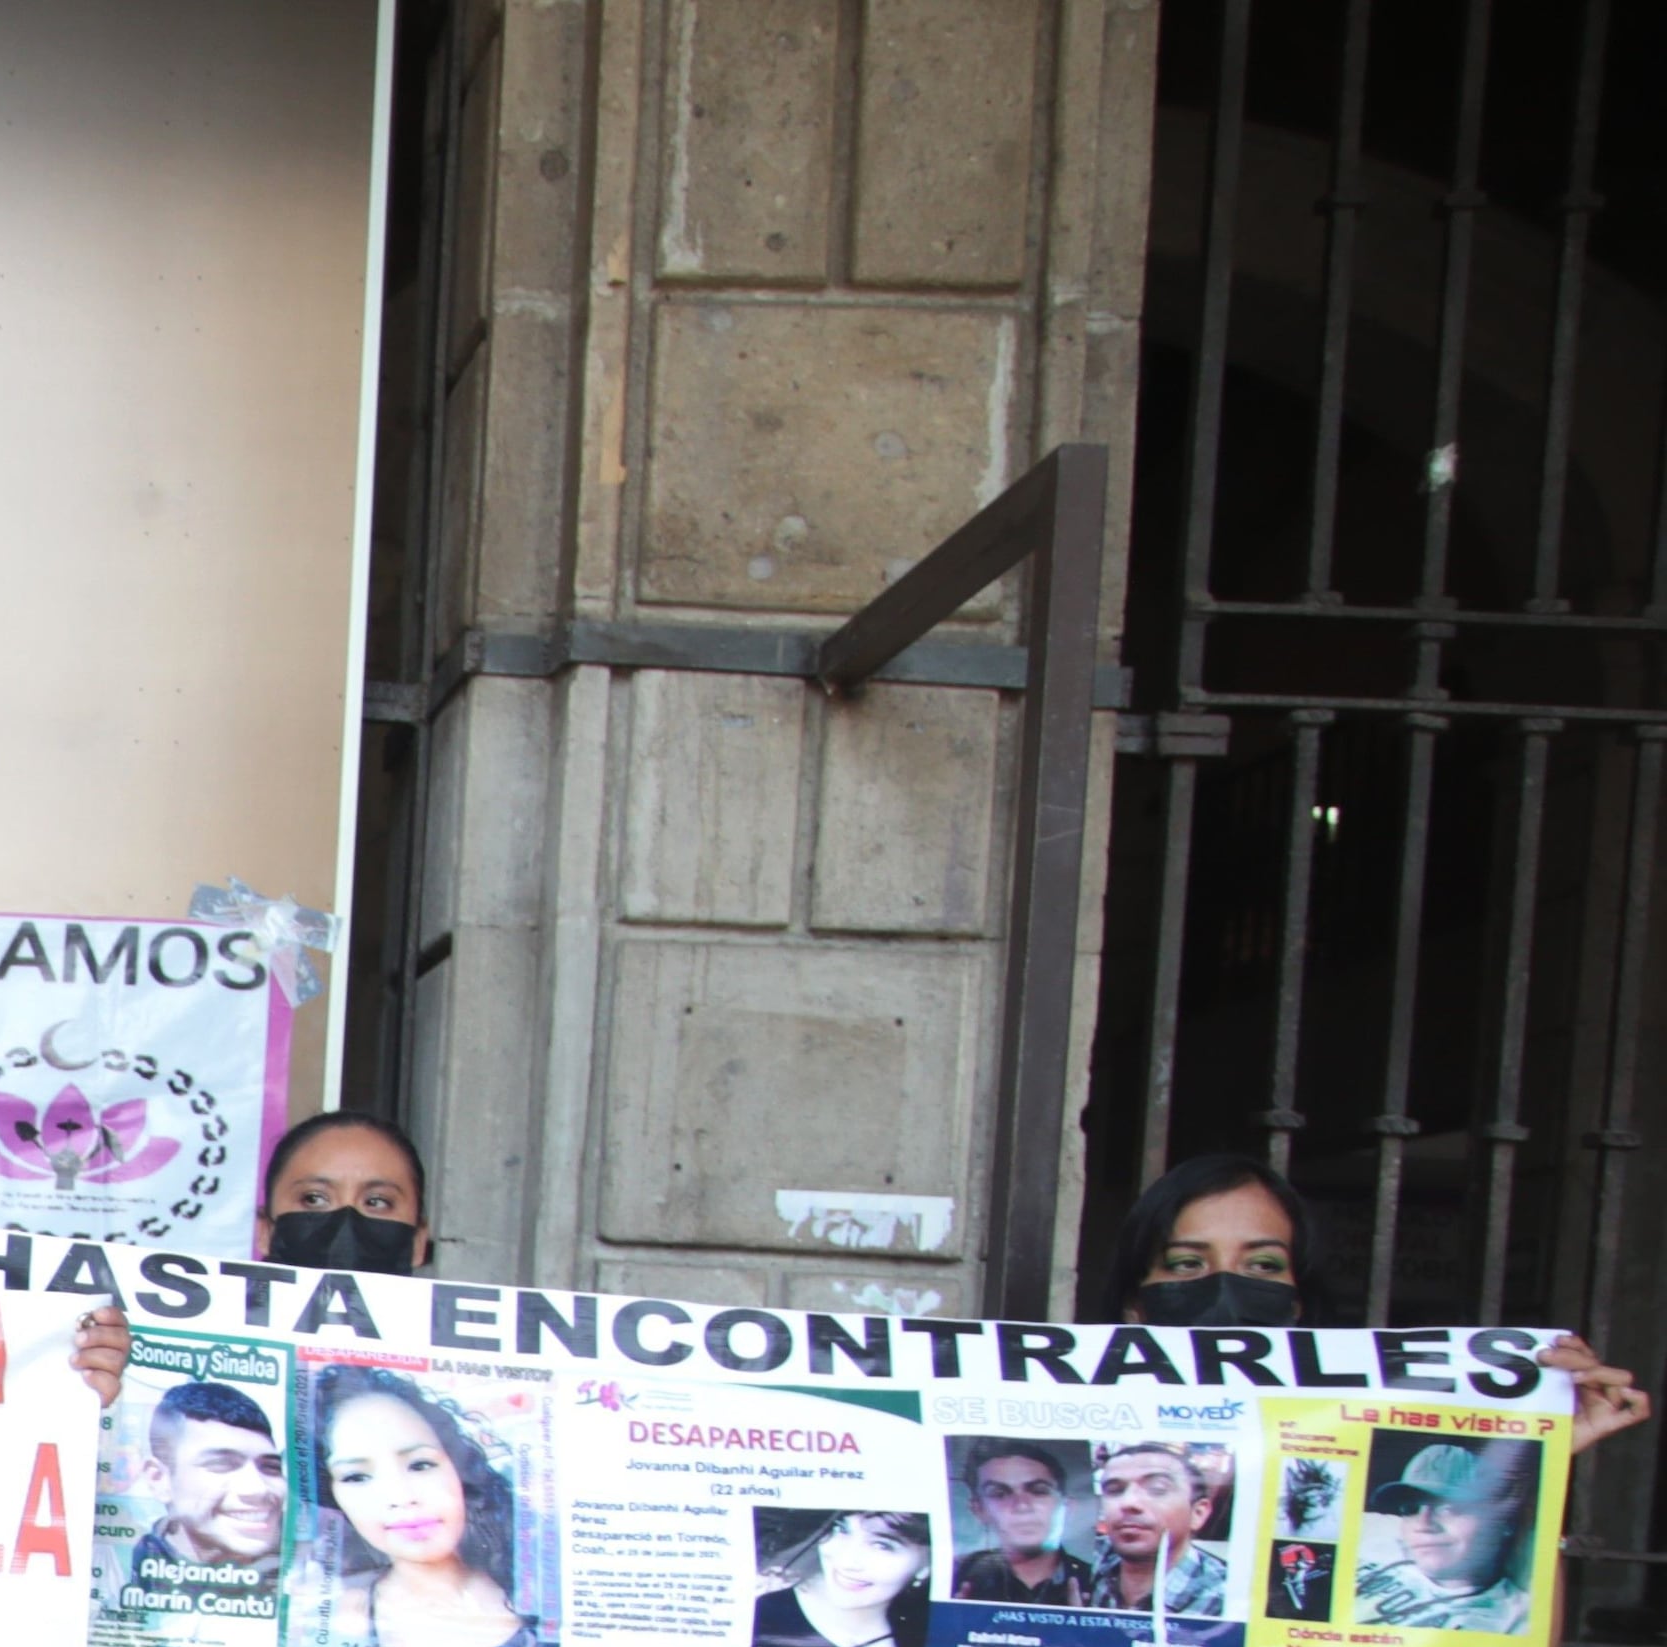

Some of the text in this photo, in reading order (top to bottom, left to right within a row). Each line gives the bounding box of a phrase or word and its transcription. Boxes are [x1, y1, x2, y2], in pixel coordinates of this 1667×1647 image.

[429, 1283, 1548, 1400] ENCONTRARLES
[131, 1341, 278, 1381] Sonora y Sinaloa
[629, 1420, 862, 1456] DESAPARECIDA
[140, 1558, 259, 1588] Alejandro
[198, 1592, 274, 1619] Cantú
